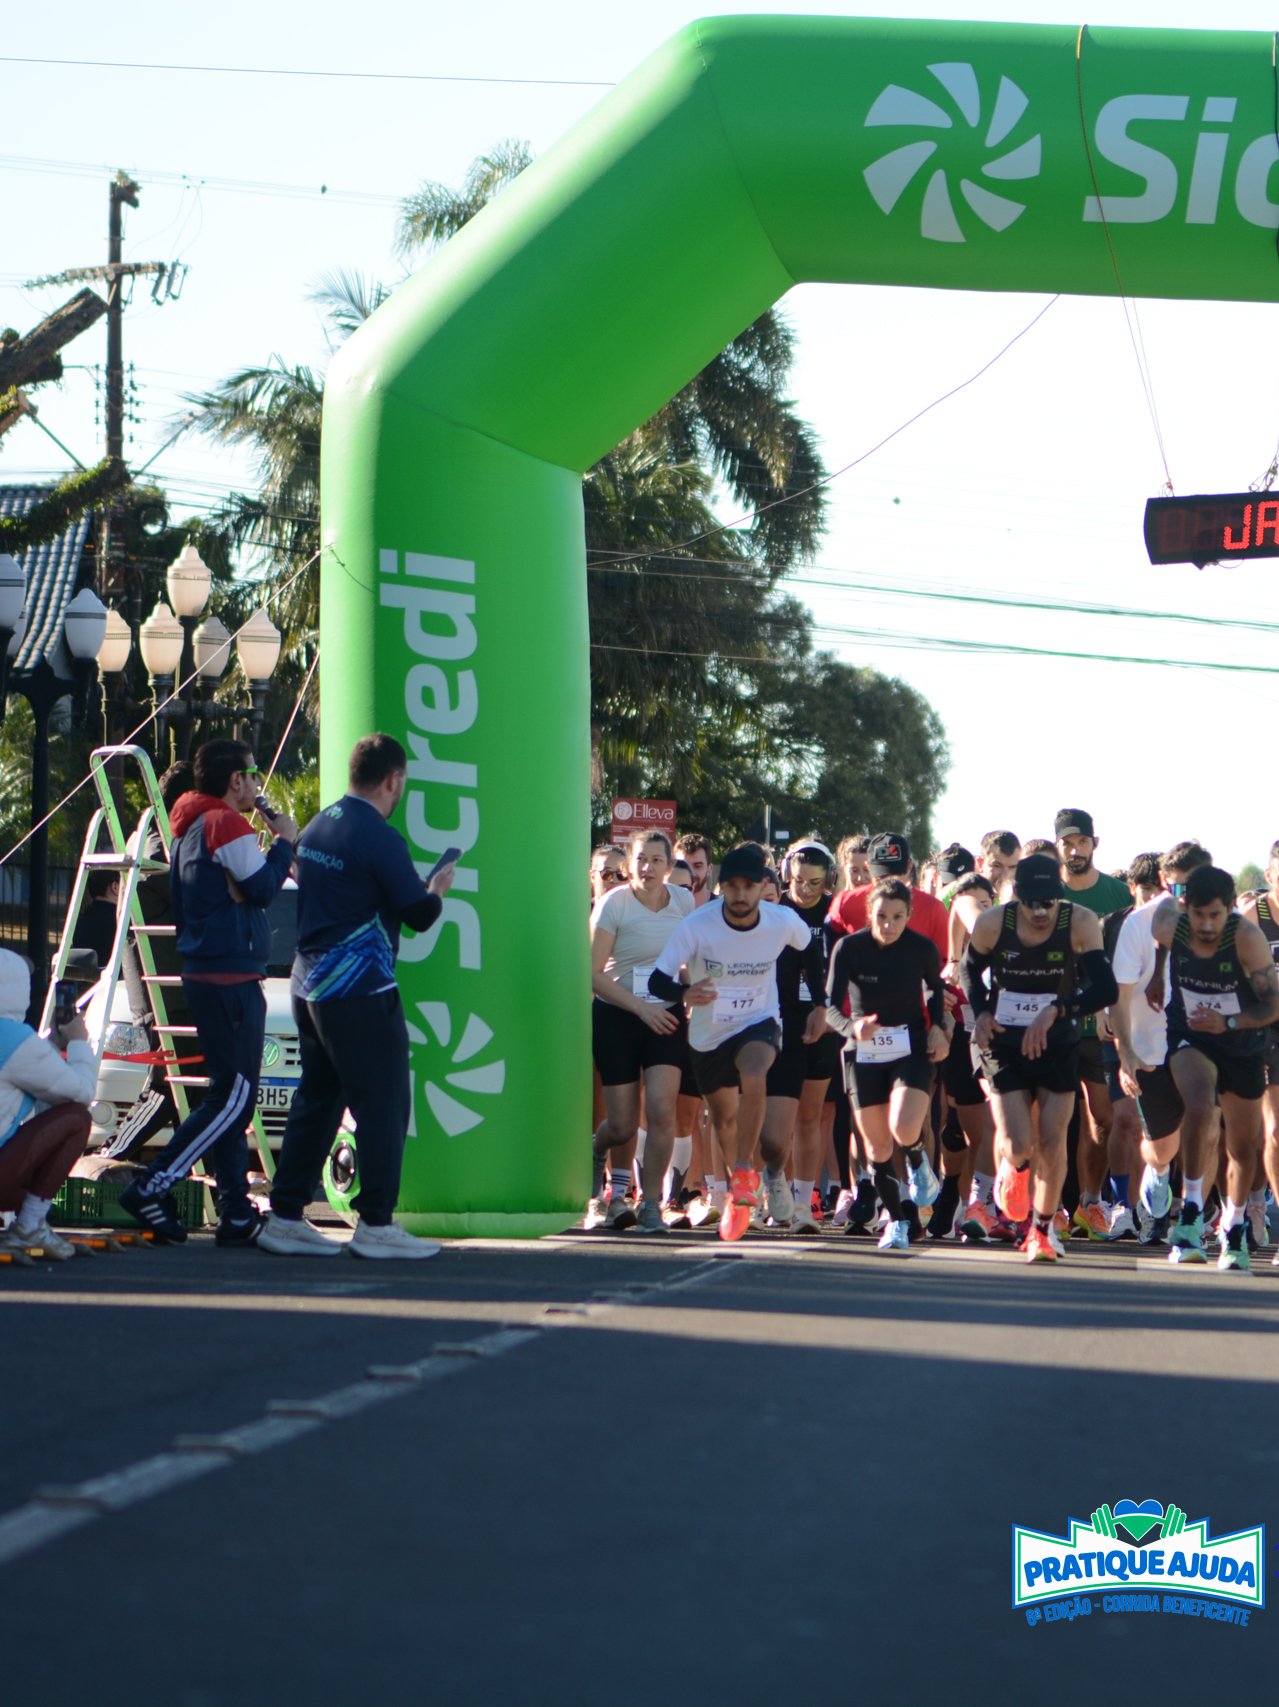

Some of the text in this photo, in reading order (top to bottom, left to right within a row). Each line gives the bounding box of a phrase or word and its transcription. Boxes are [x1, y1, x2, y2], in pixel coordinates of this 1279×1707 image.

[633, 803, 674, 820] Elleva
[732, 999, 754, 1009] 177
[1015, 1003, 1039, 1012] 145
[871, 1036, 894, 1046] 135
